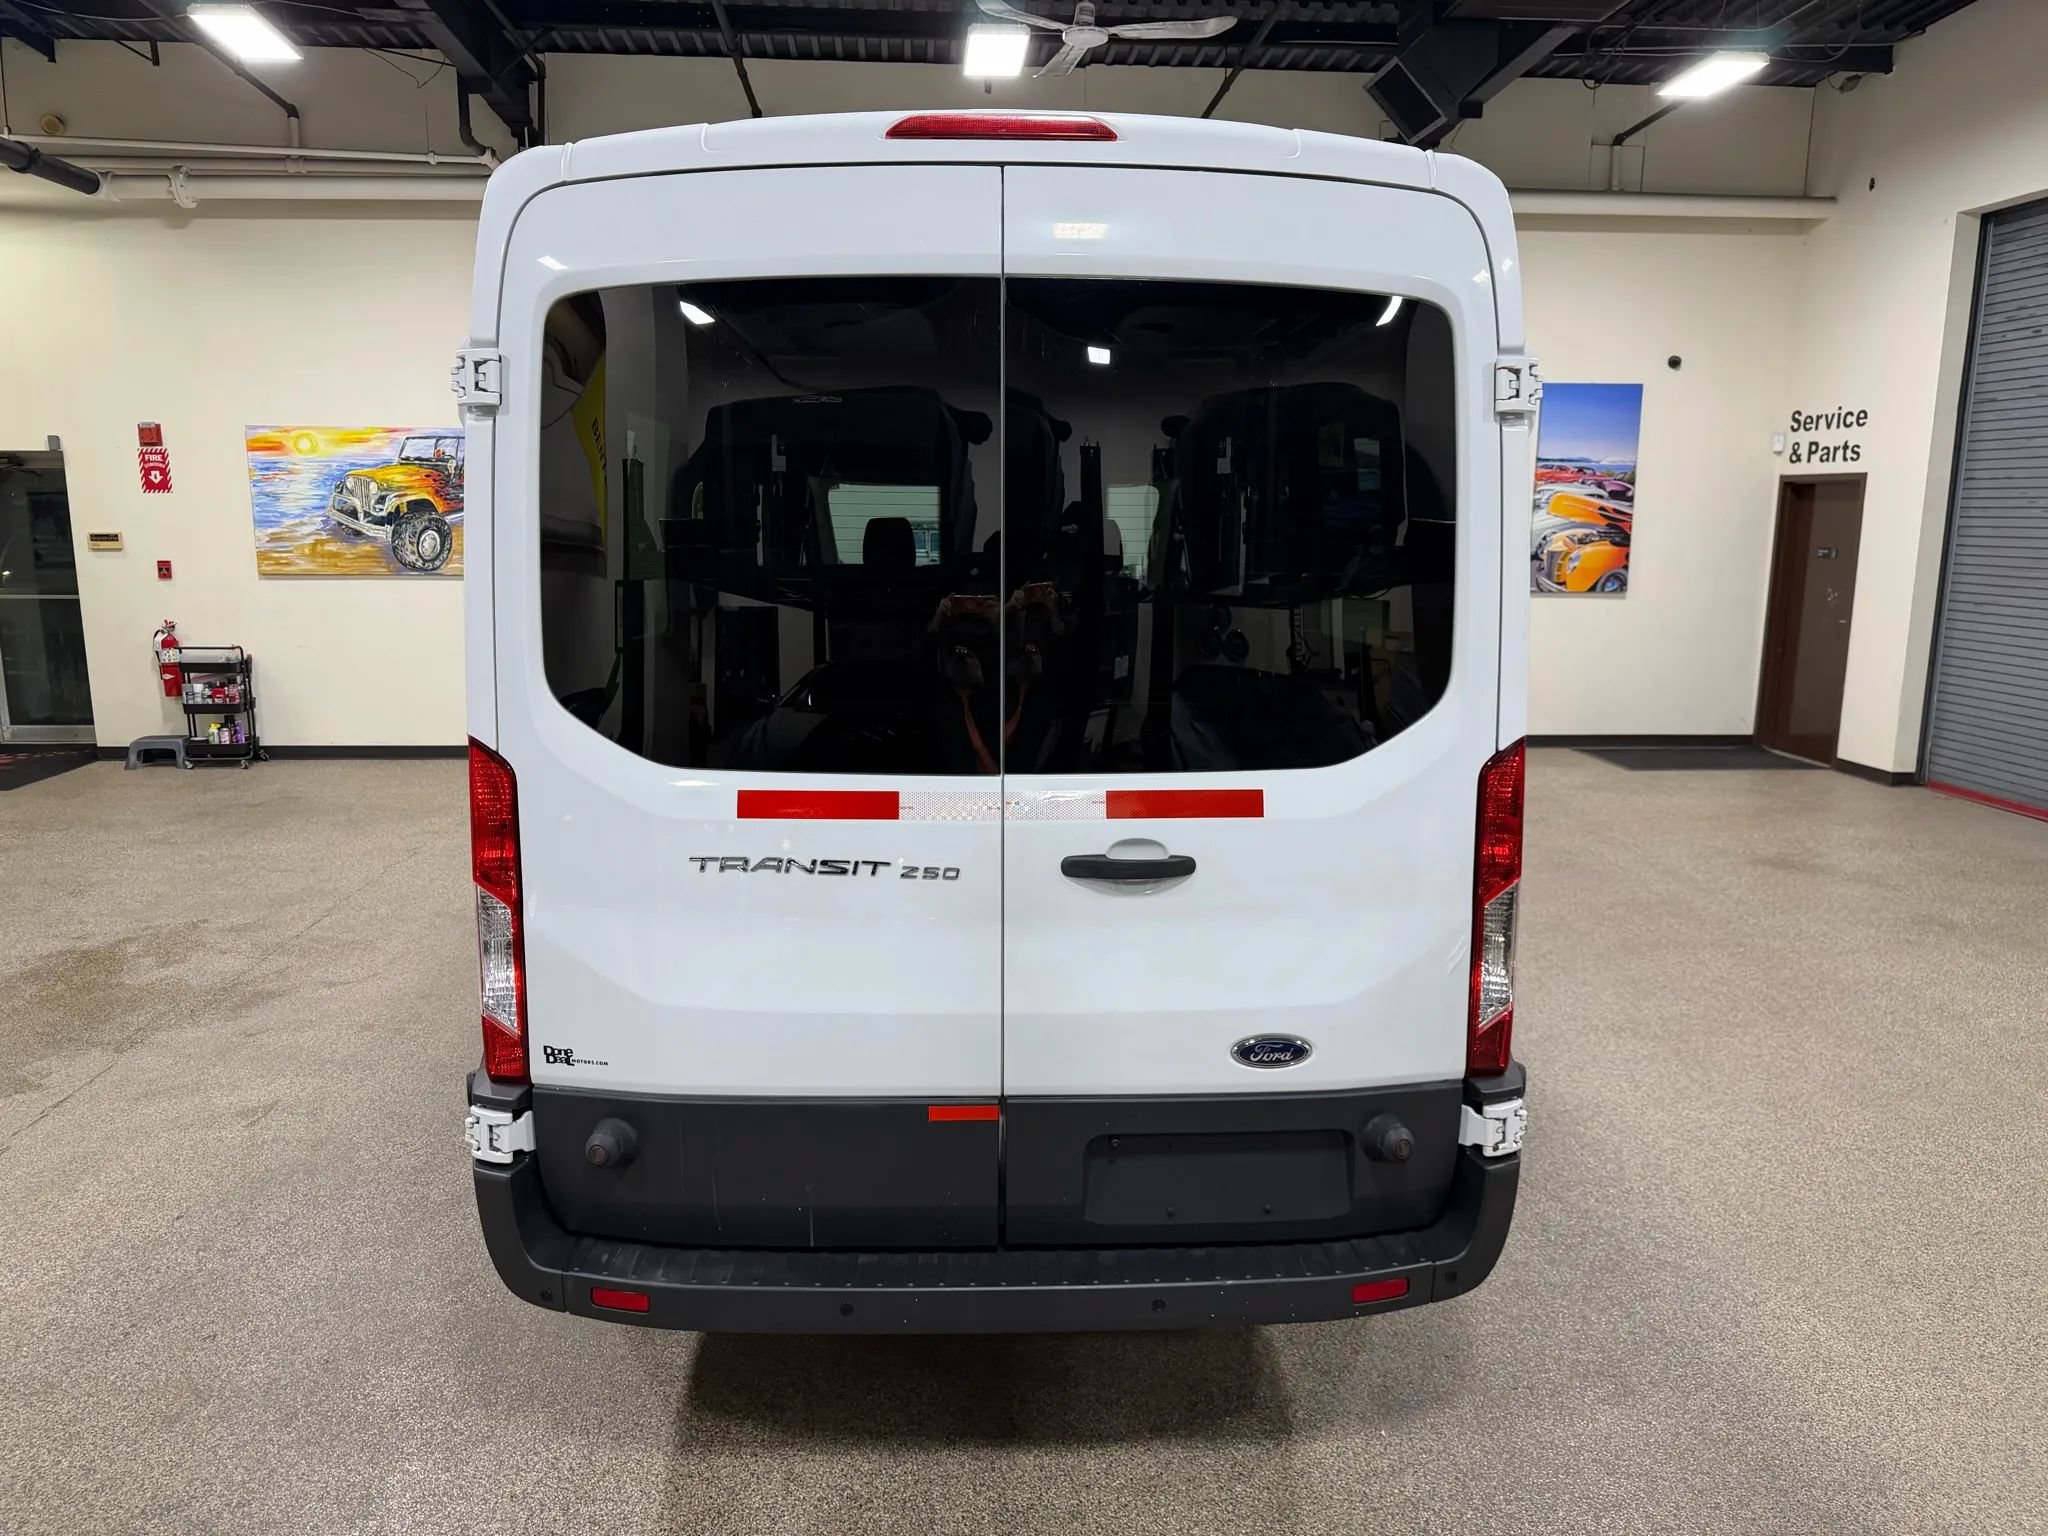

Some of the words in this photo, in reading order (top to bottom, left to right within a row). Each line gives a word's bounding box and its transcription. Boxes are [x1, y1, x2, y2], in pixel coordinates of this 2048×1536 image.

[1790, 406, 1868, 433] Service
[144, 454, 164, 462] FIRE
[1789, 441, 1802, 464] &
[1807, 439, 1861, 464] Parts
[688, 856, 892, 877] TRANSIT
[900, 865, 961, 881] 250
[543, 1045, 574, 1057] Done
[1250, 1043, 1294, 1062] Ford
